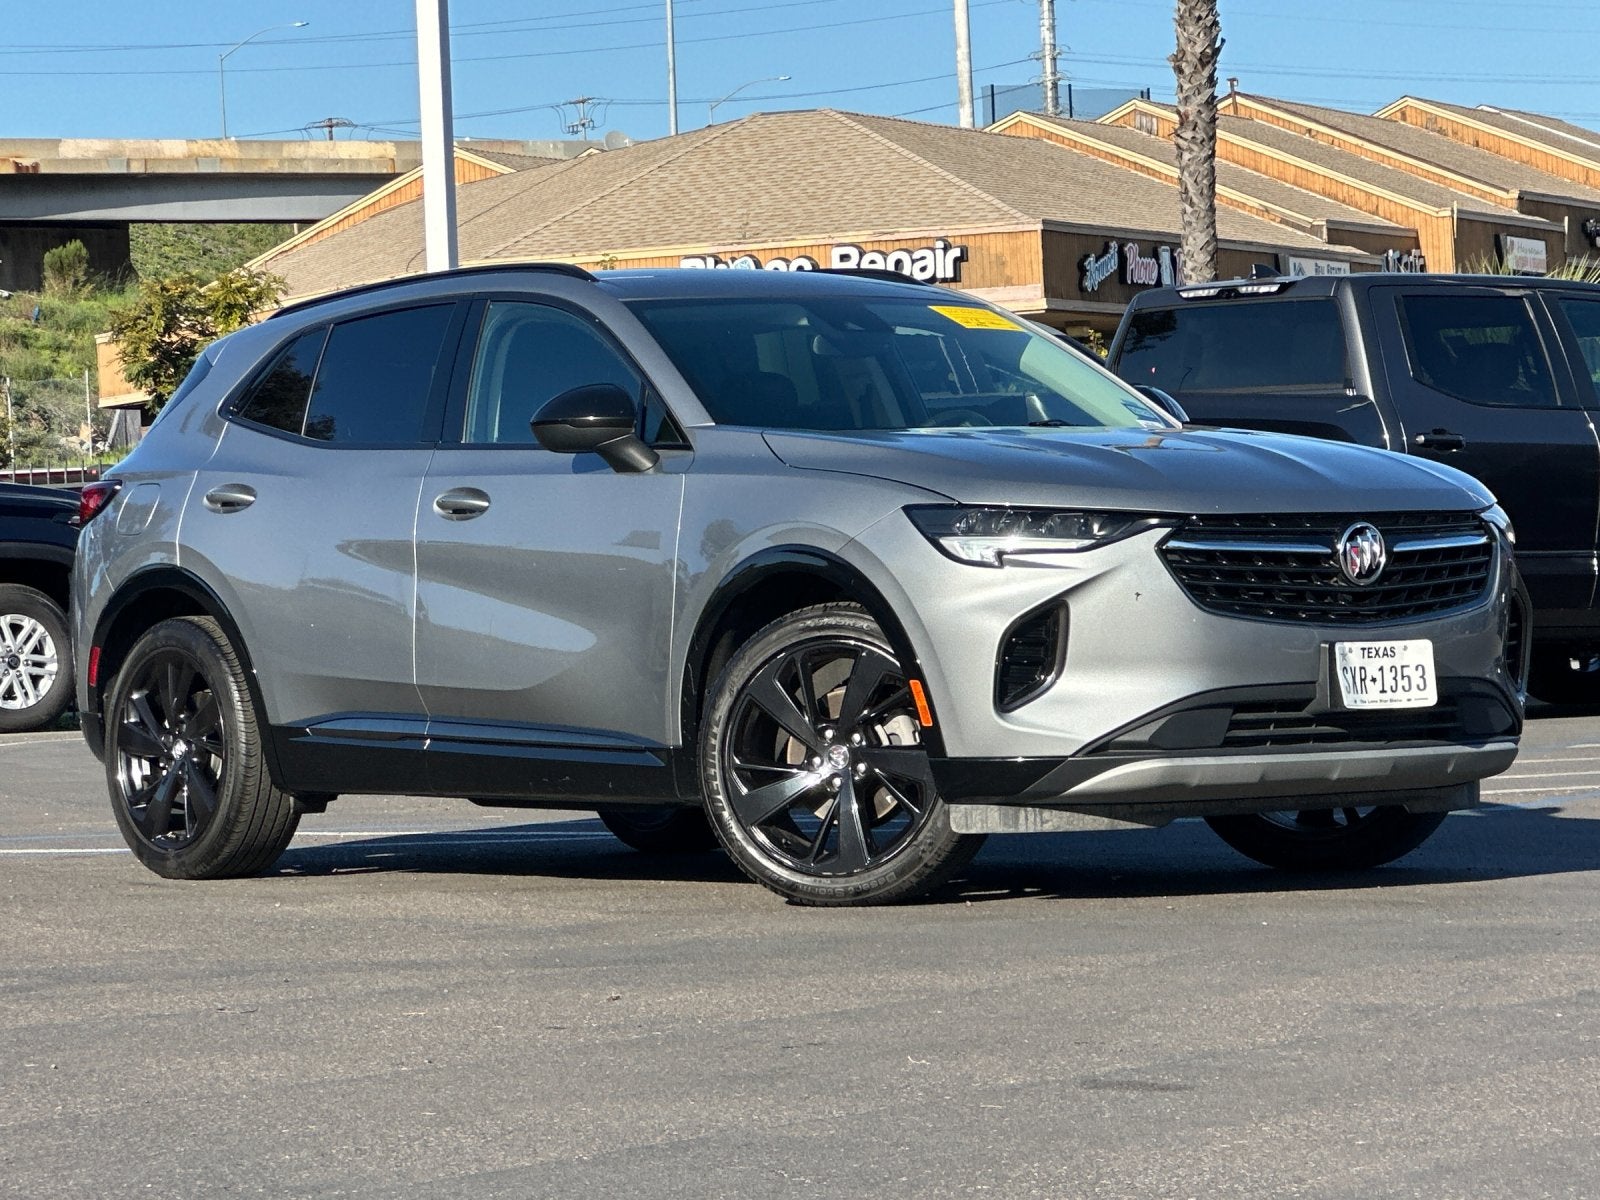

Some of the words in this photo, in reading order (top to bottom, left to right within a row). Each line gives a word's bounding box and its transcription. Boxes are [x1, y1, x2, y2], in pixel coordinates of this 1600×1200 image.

[830, 238, 964, 281] Repair
[1124, 242, 1159, 285] Phone
[1360, 646, 1397, 659] TEXAS
[1342, 666, 1369, 695] SXR
[1378, 664, 1428, 694] 1353
